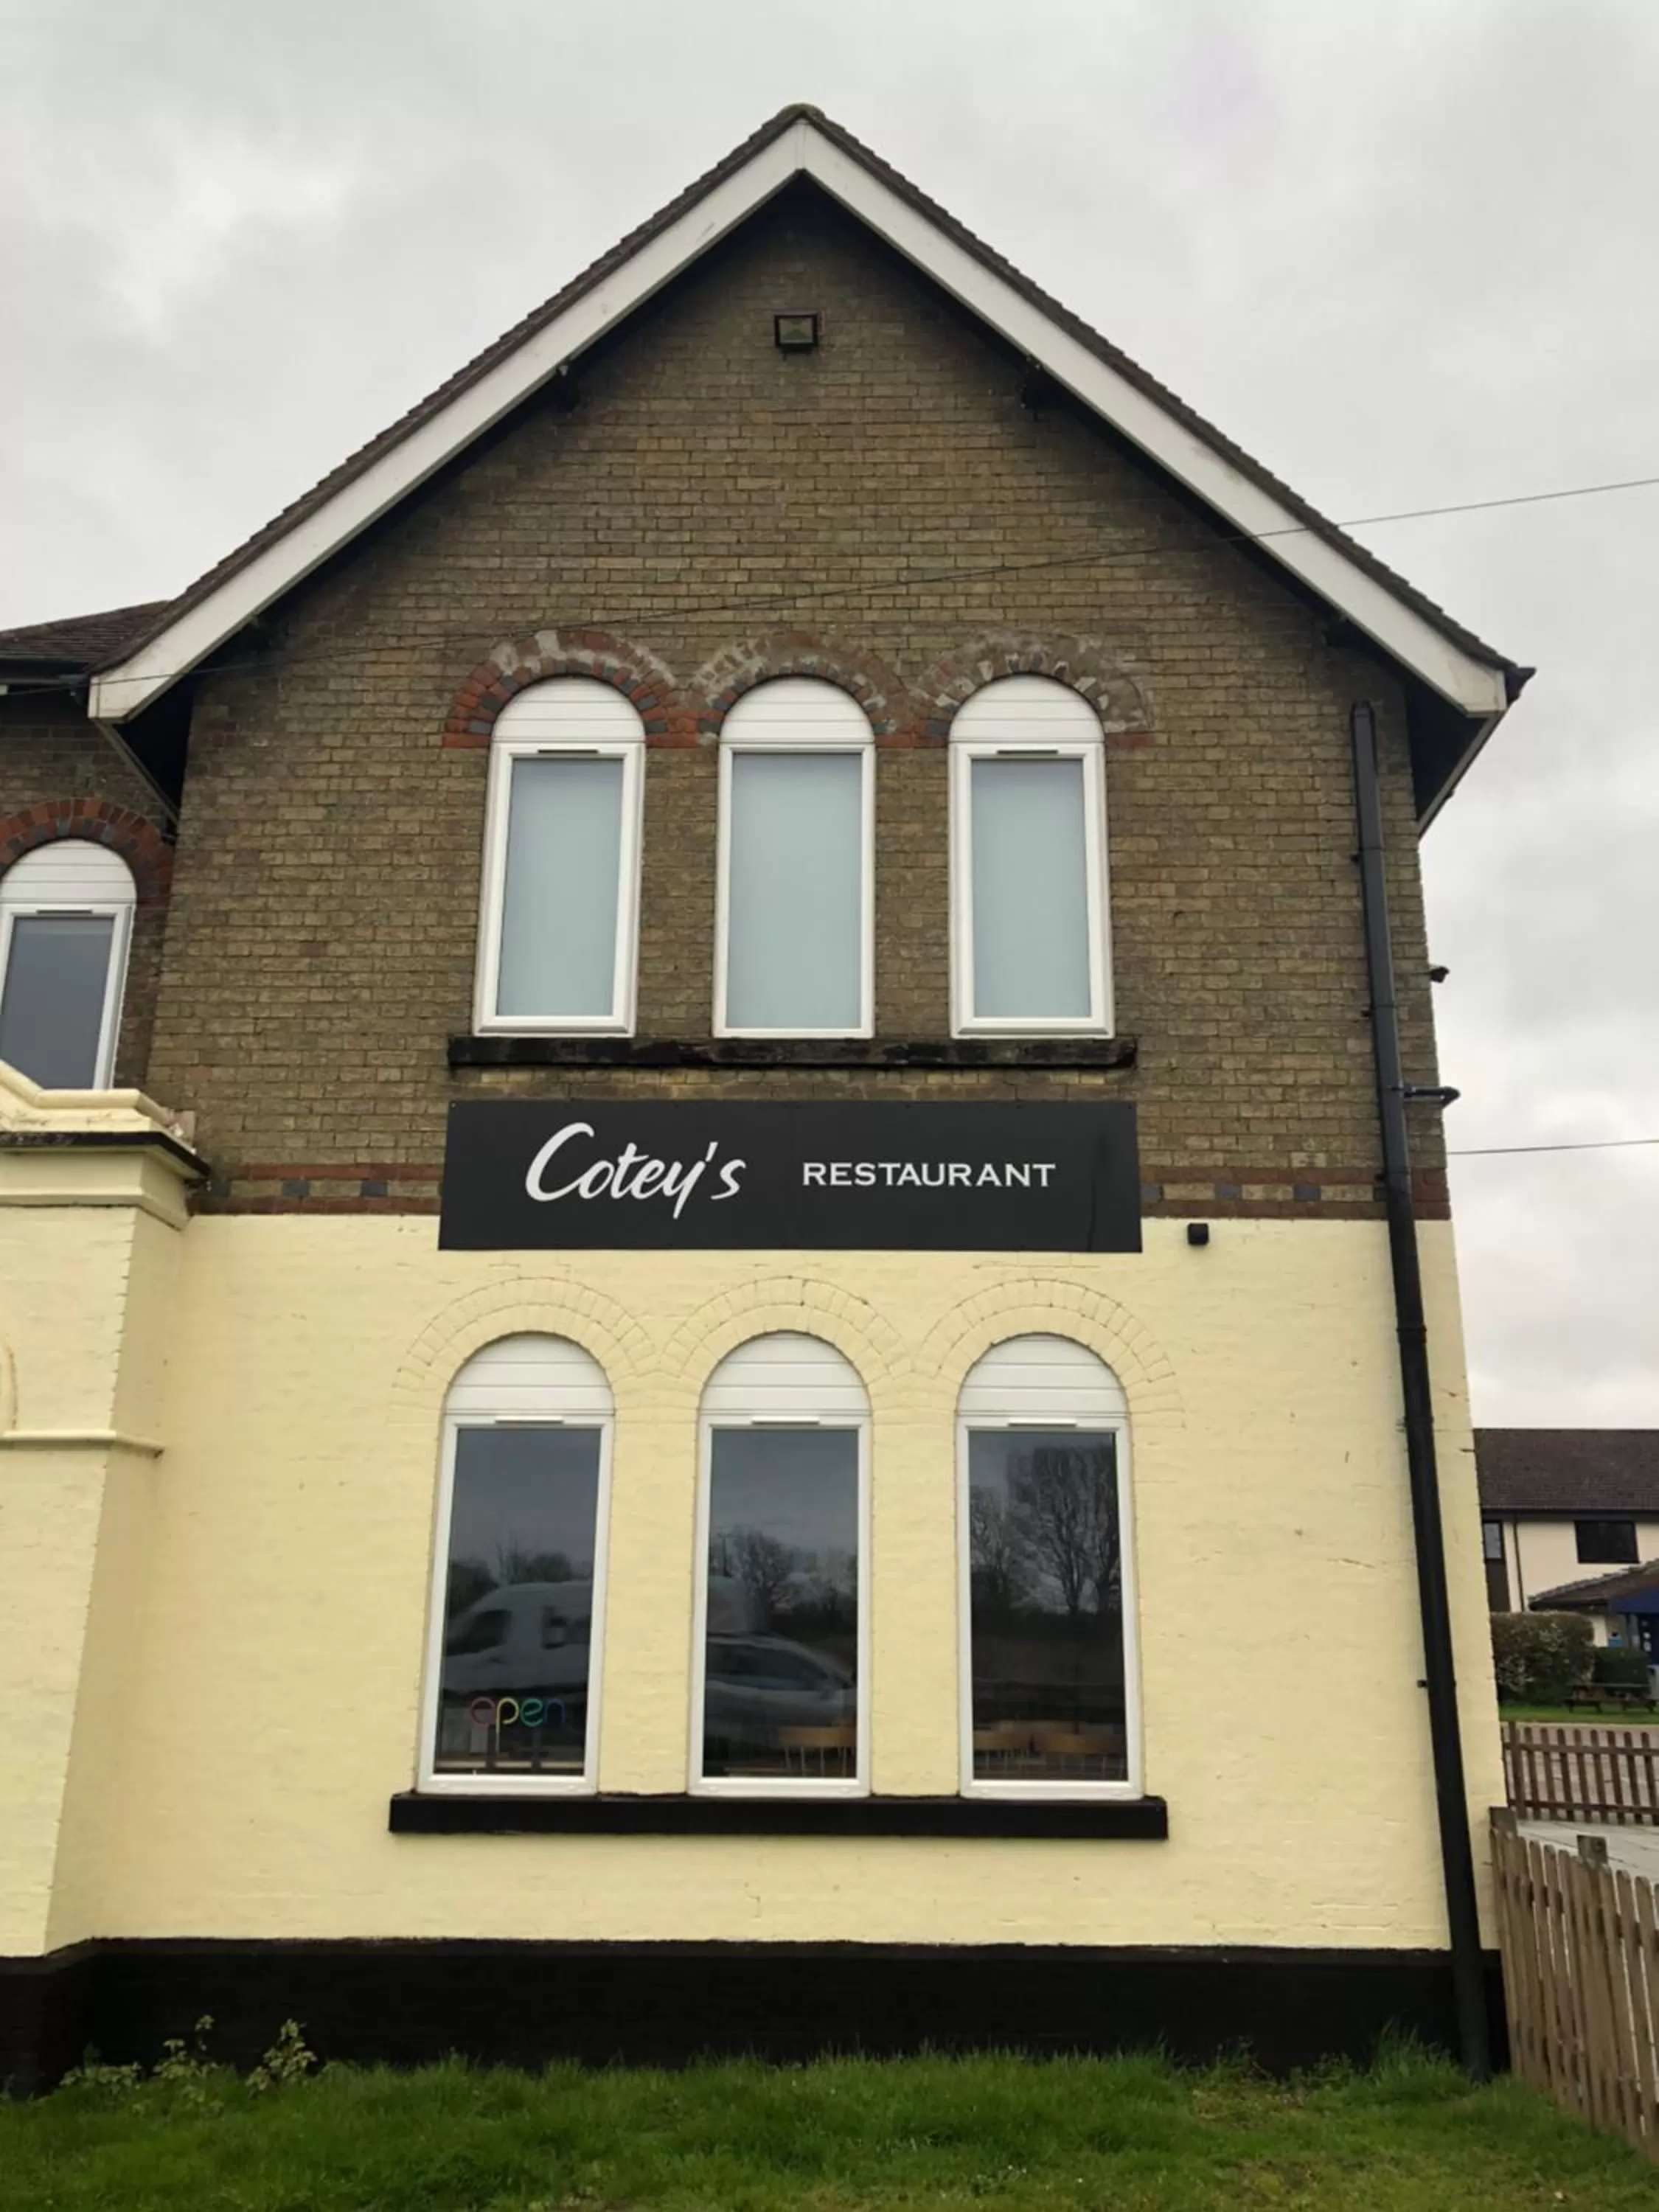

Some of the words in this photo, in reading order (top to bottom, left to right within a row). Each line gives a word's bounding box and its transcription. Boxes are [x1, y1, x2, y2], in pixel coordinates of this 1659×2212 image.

[524, 1122, 746, 1219] Cotey's
[802, 1162, 1056, 1187] RESTAURANT
[470, 1697, 566, 1752] open
